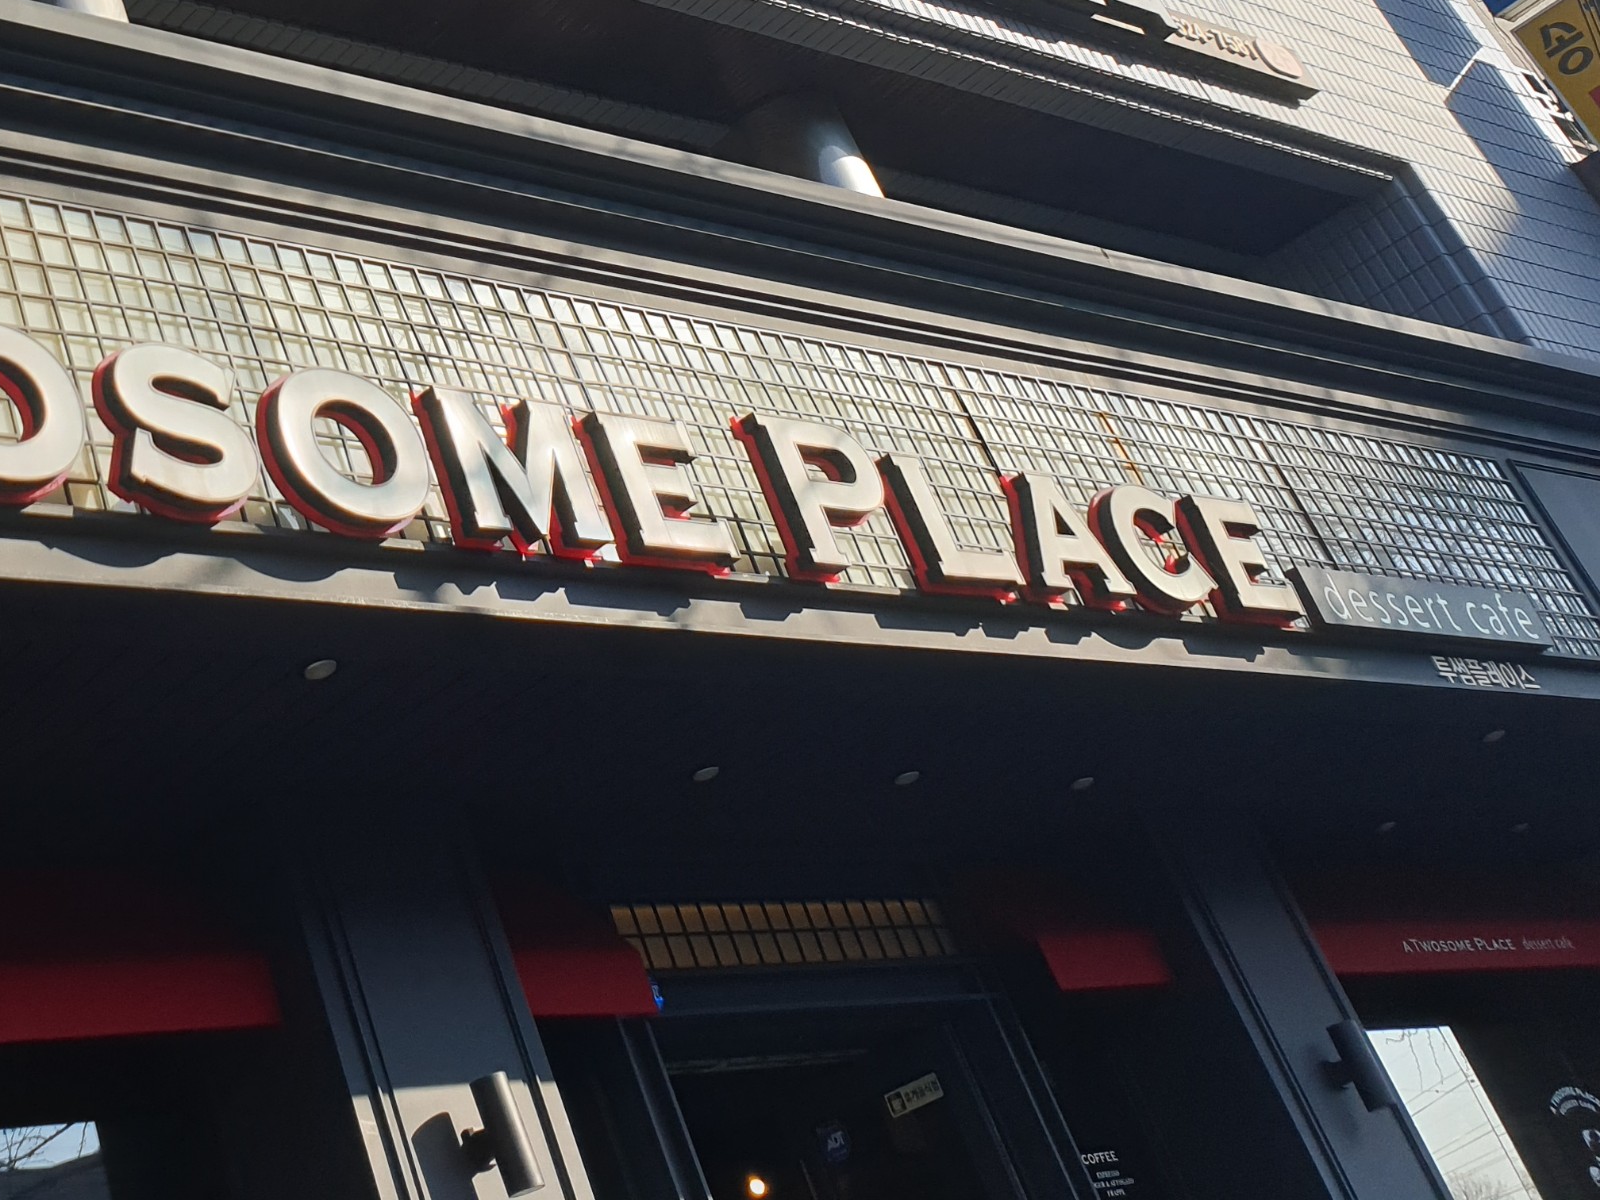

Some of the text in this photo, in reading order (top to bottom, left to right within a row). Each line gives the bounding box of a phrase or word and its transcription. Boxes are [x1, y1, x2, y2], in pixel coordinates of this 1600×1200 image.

[738, 412, 1304, 625] PLACE
[1323, 573, 1540, 640] dessert cafe
[1430, 655, 1542, 690] 투썸플레이스
[1410, 938, 1475, 953] TWOSOME
[1474, 937, 1517, 951] PLACE
[1081, 1150, 1119, 1164] COFFEE
